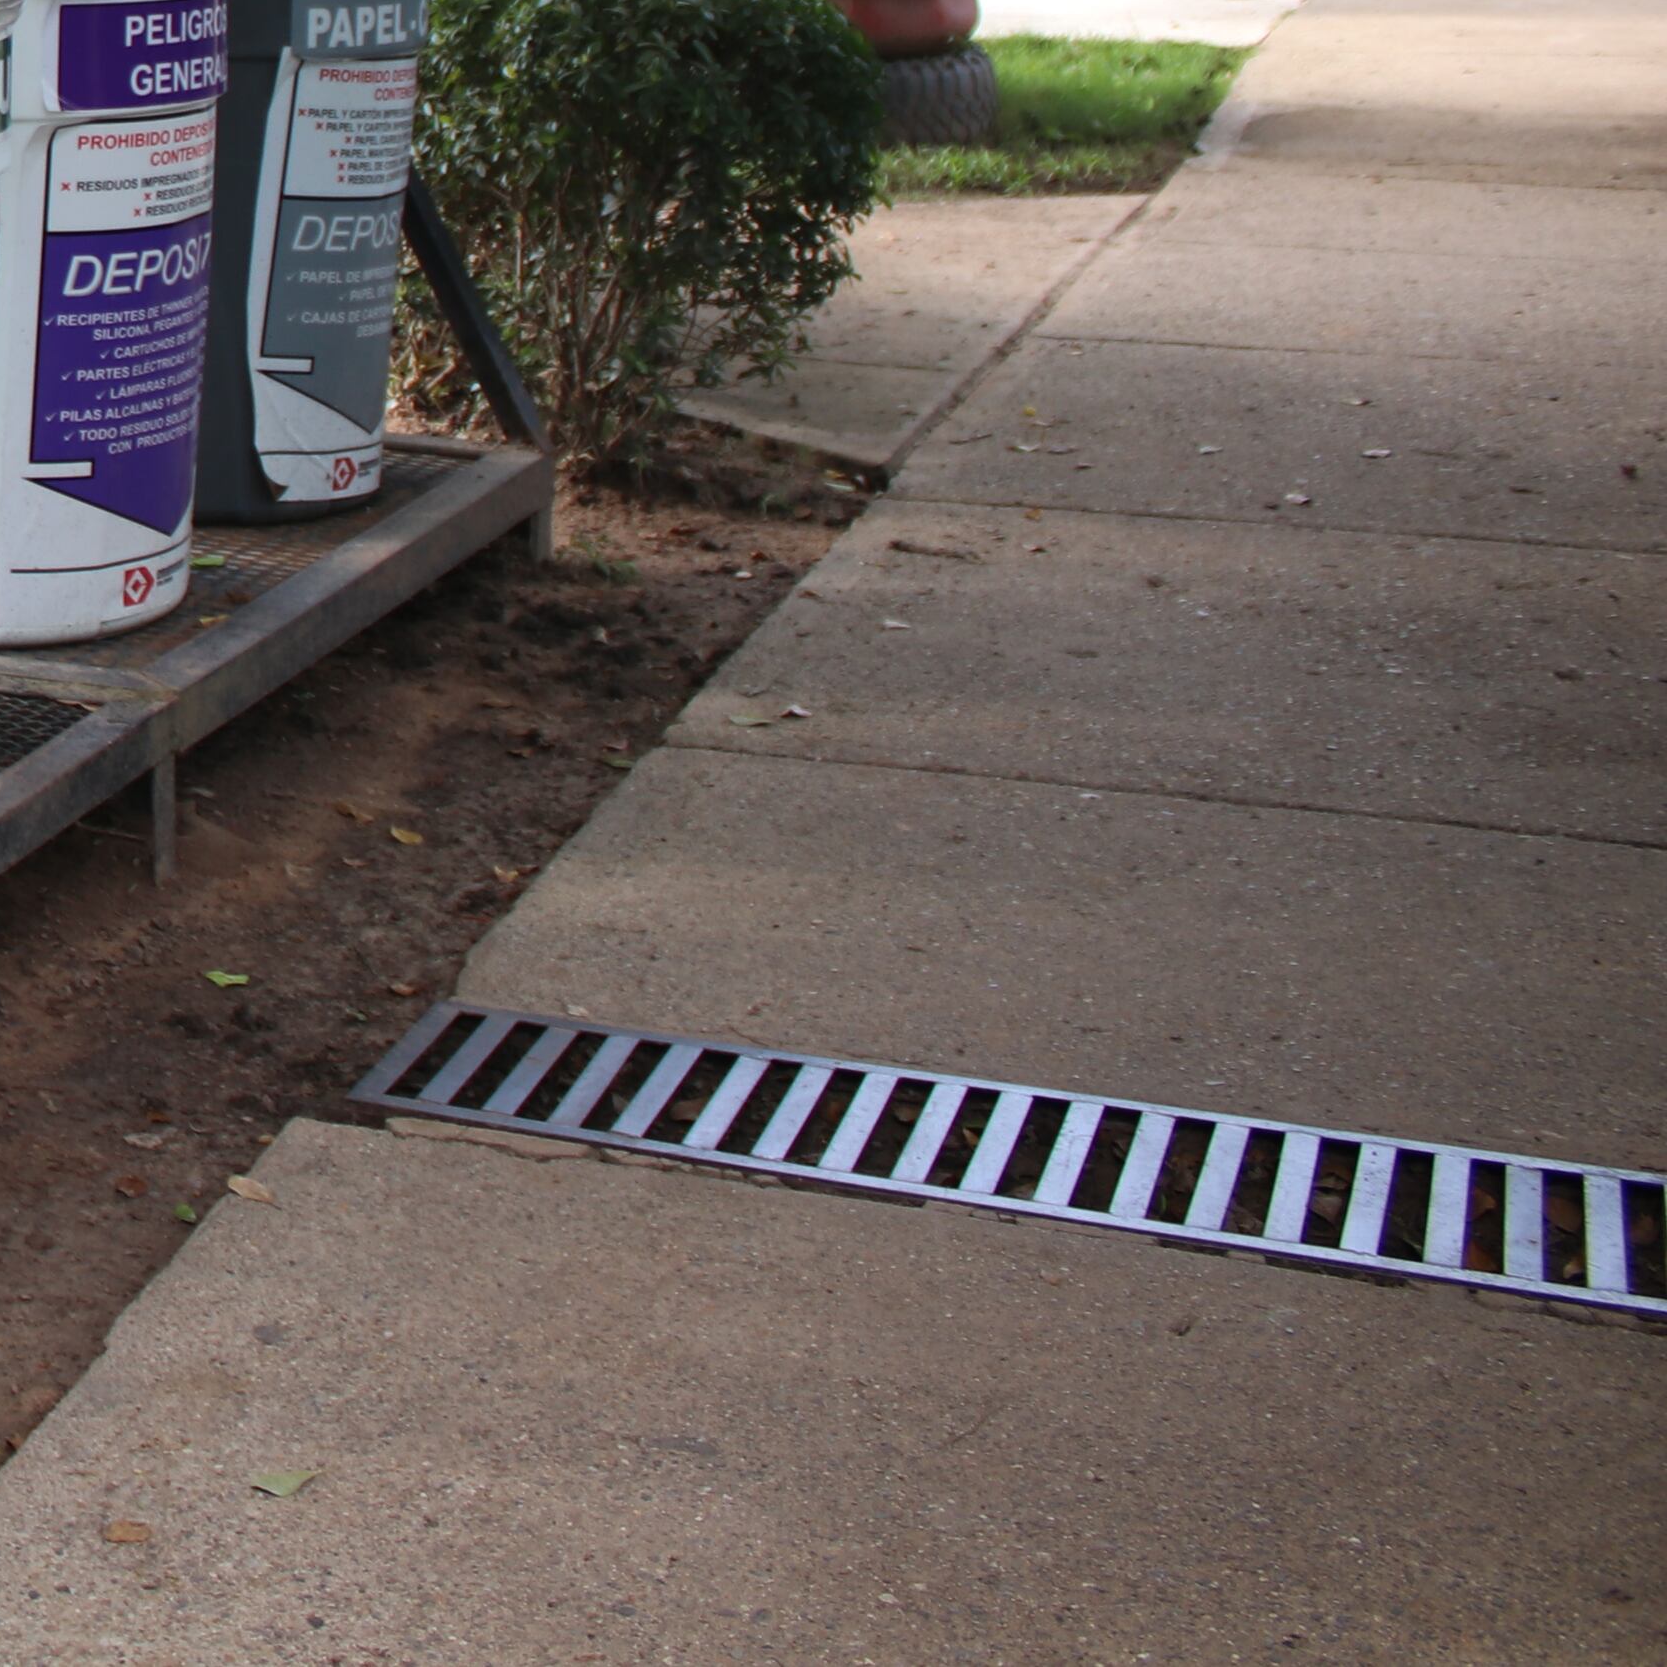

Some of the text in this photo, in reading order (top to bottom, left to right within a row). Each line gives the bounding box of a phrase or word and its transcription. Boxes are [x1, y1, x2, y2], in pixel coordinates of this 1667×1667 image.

[307, 4, 407, 48] PAPEL
[78, 131, 170, 150] PROHIBIDO
[60, 410, 102, 423] PILAS
